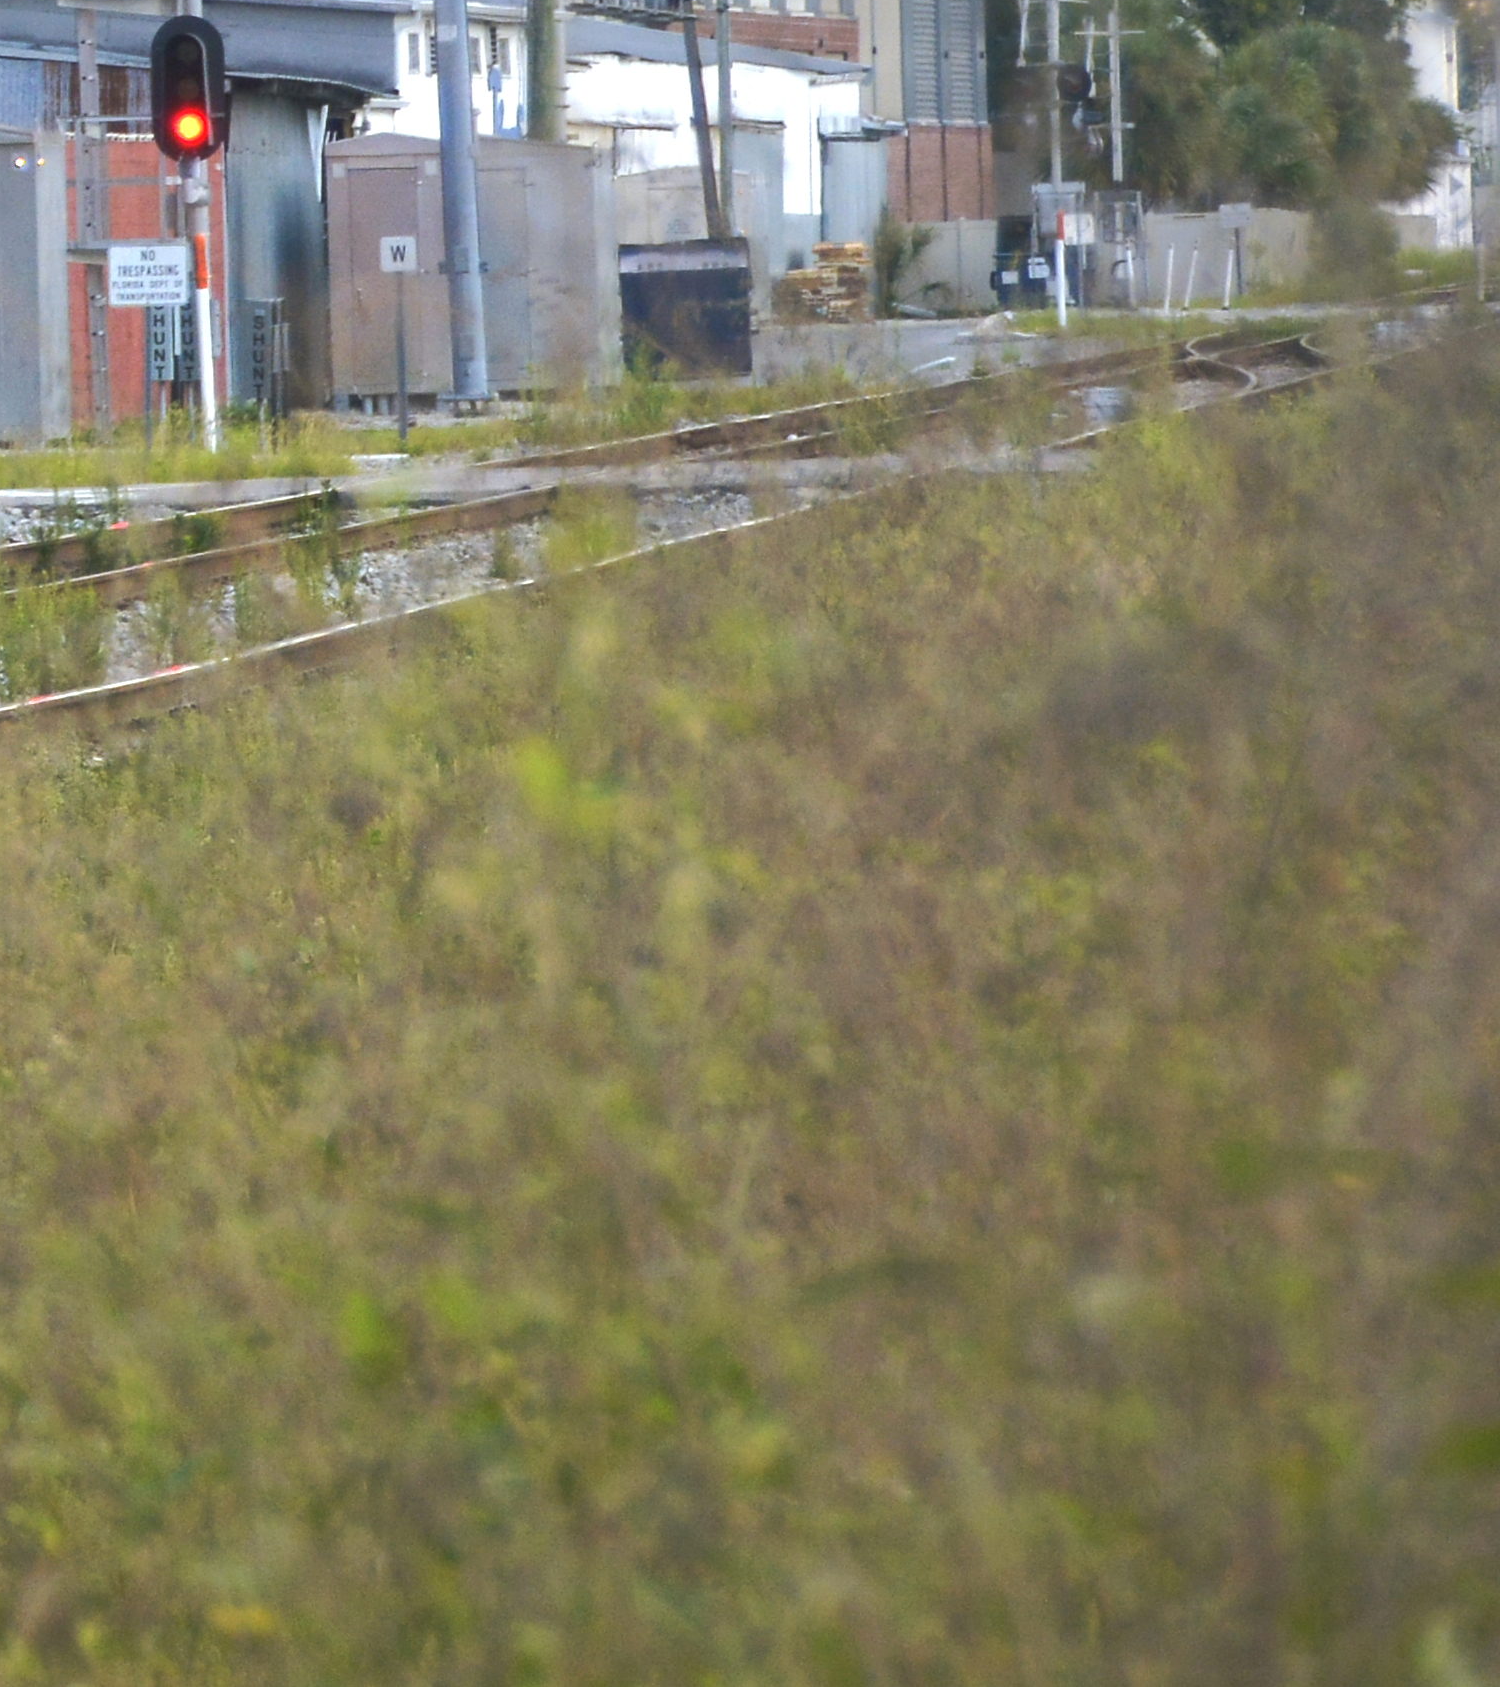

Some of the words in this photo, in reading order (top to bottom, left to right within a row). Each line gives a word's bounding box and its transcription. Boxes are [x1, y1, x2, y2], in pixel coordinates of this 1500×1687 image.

[140, 249, 156, 262] NO
[390, 245, 406, 263] W
[117, 264, 180, 278] TRESPASSING
[112, 280, 144, 290] FLORIDA
[174, 279, 184, 288] OF
[115, 292, 182, 301] TRANSPORTATION
[252, 315, 266, 401] SHUNT
